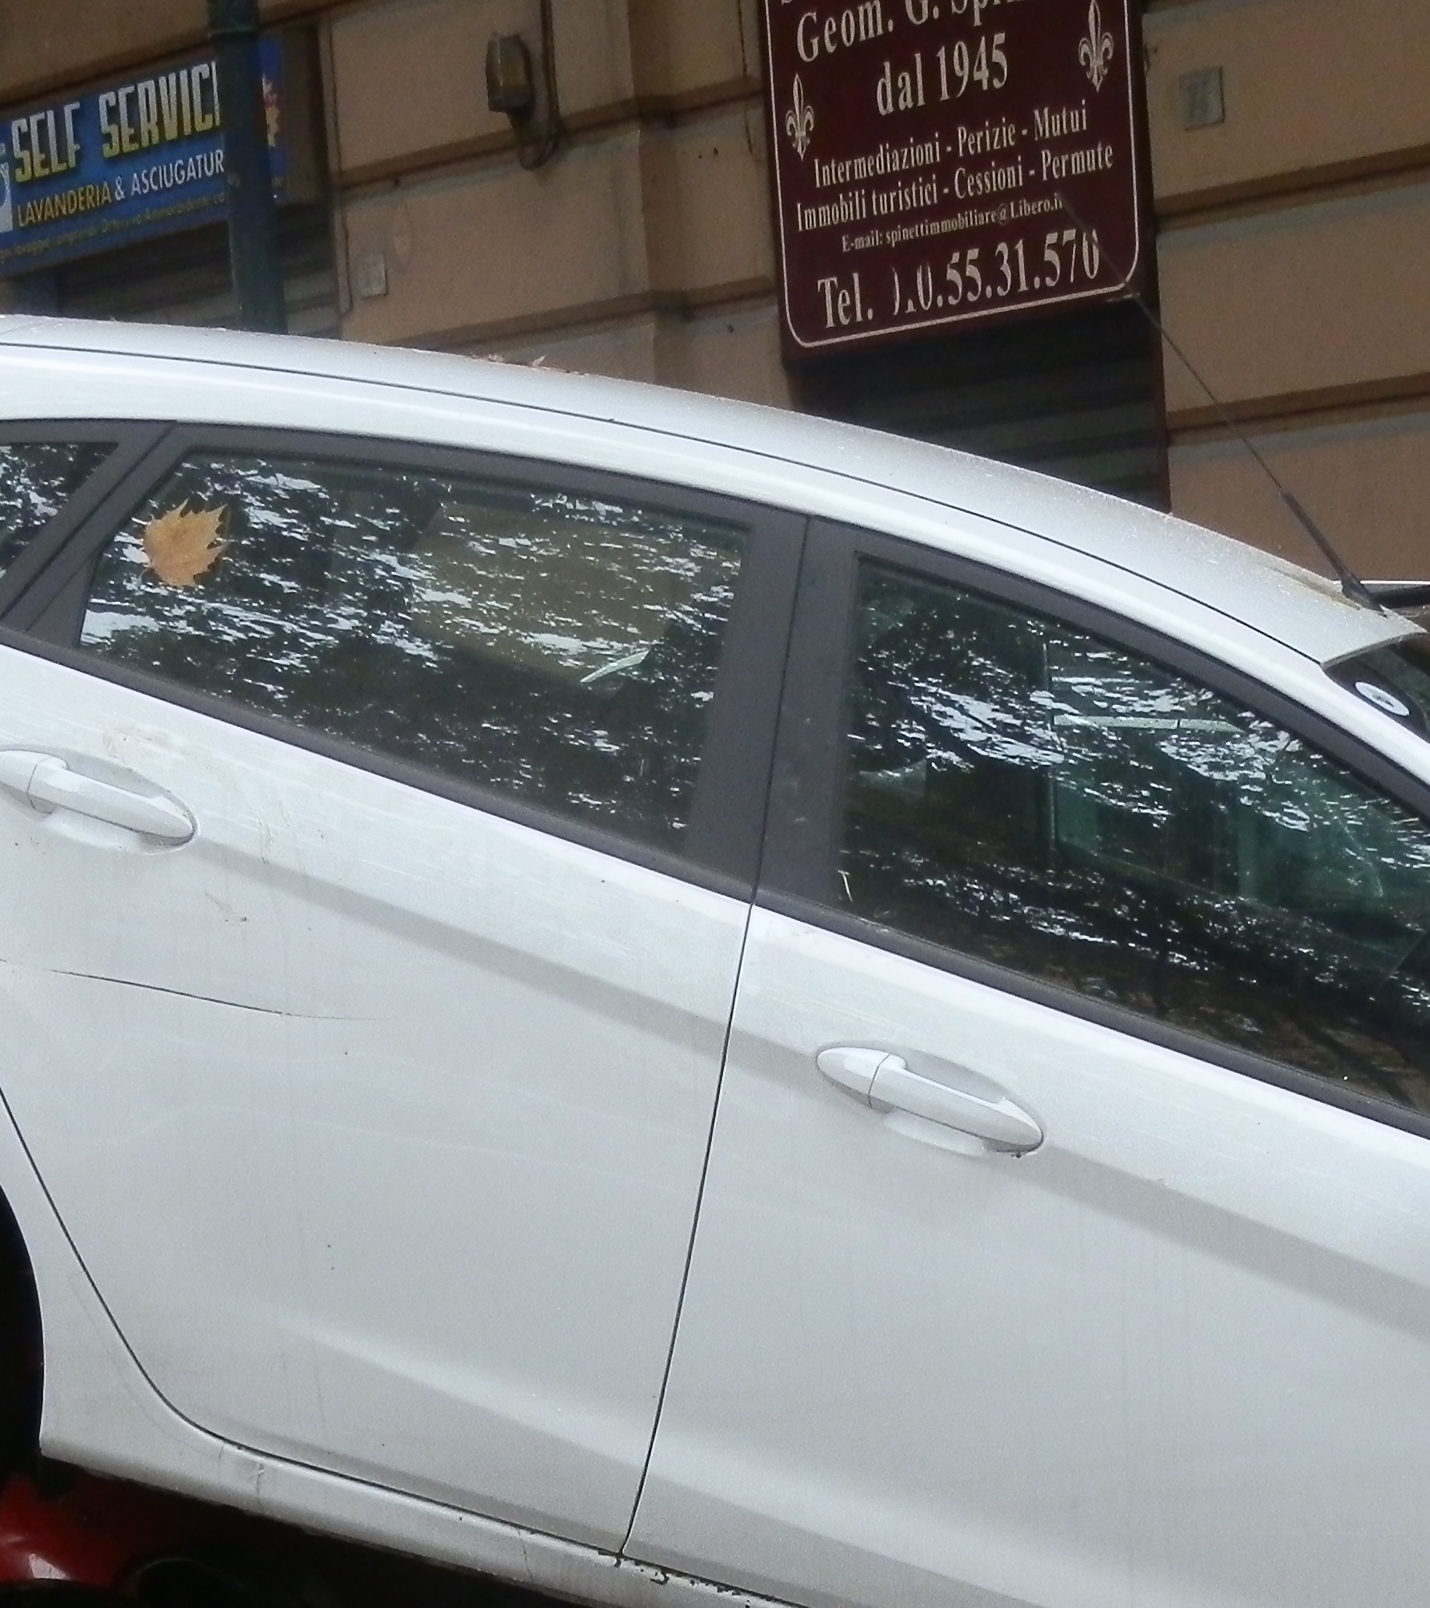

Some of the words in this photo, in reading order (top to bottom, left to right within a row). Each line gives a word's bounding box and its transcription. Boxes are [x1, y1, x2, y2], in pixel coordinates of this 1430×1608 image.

[797, 1, 894, 63] Geom.
[876, 52, 925, 116] dal
[936, 32, 1008, 102] 1945
[11, 101, 81, 183] SELF
[813, 131, 941, 188] Intermediazioni
[957, 116, 1017, 157] Perizie
[1033, 99, 1088, 142] Mutui
[17, 182, 112, 228] LAVANDERIA
[114, 176, 126, 201] &
[796, 189, 867, 231] Immobili
[872, 173, 938, 216] turistici
[954, 155, 1023, 200] Cessioni
[1040, 141, 1114, 182] Permute
[817, 272, 874, 328] Tel.
[892, 228, 1100, 316] 0.55.31.570
[841, 230, 883, 252] E-mail:
